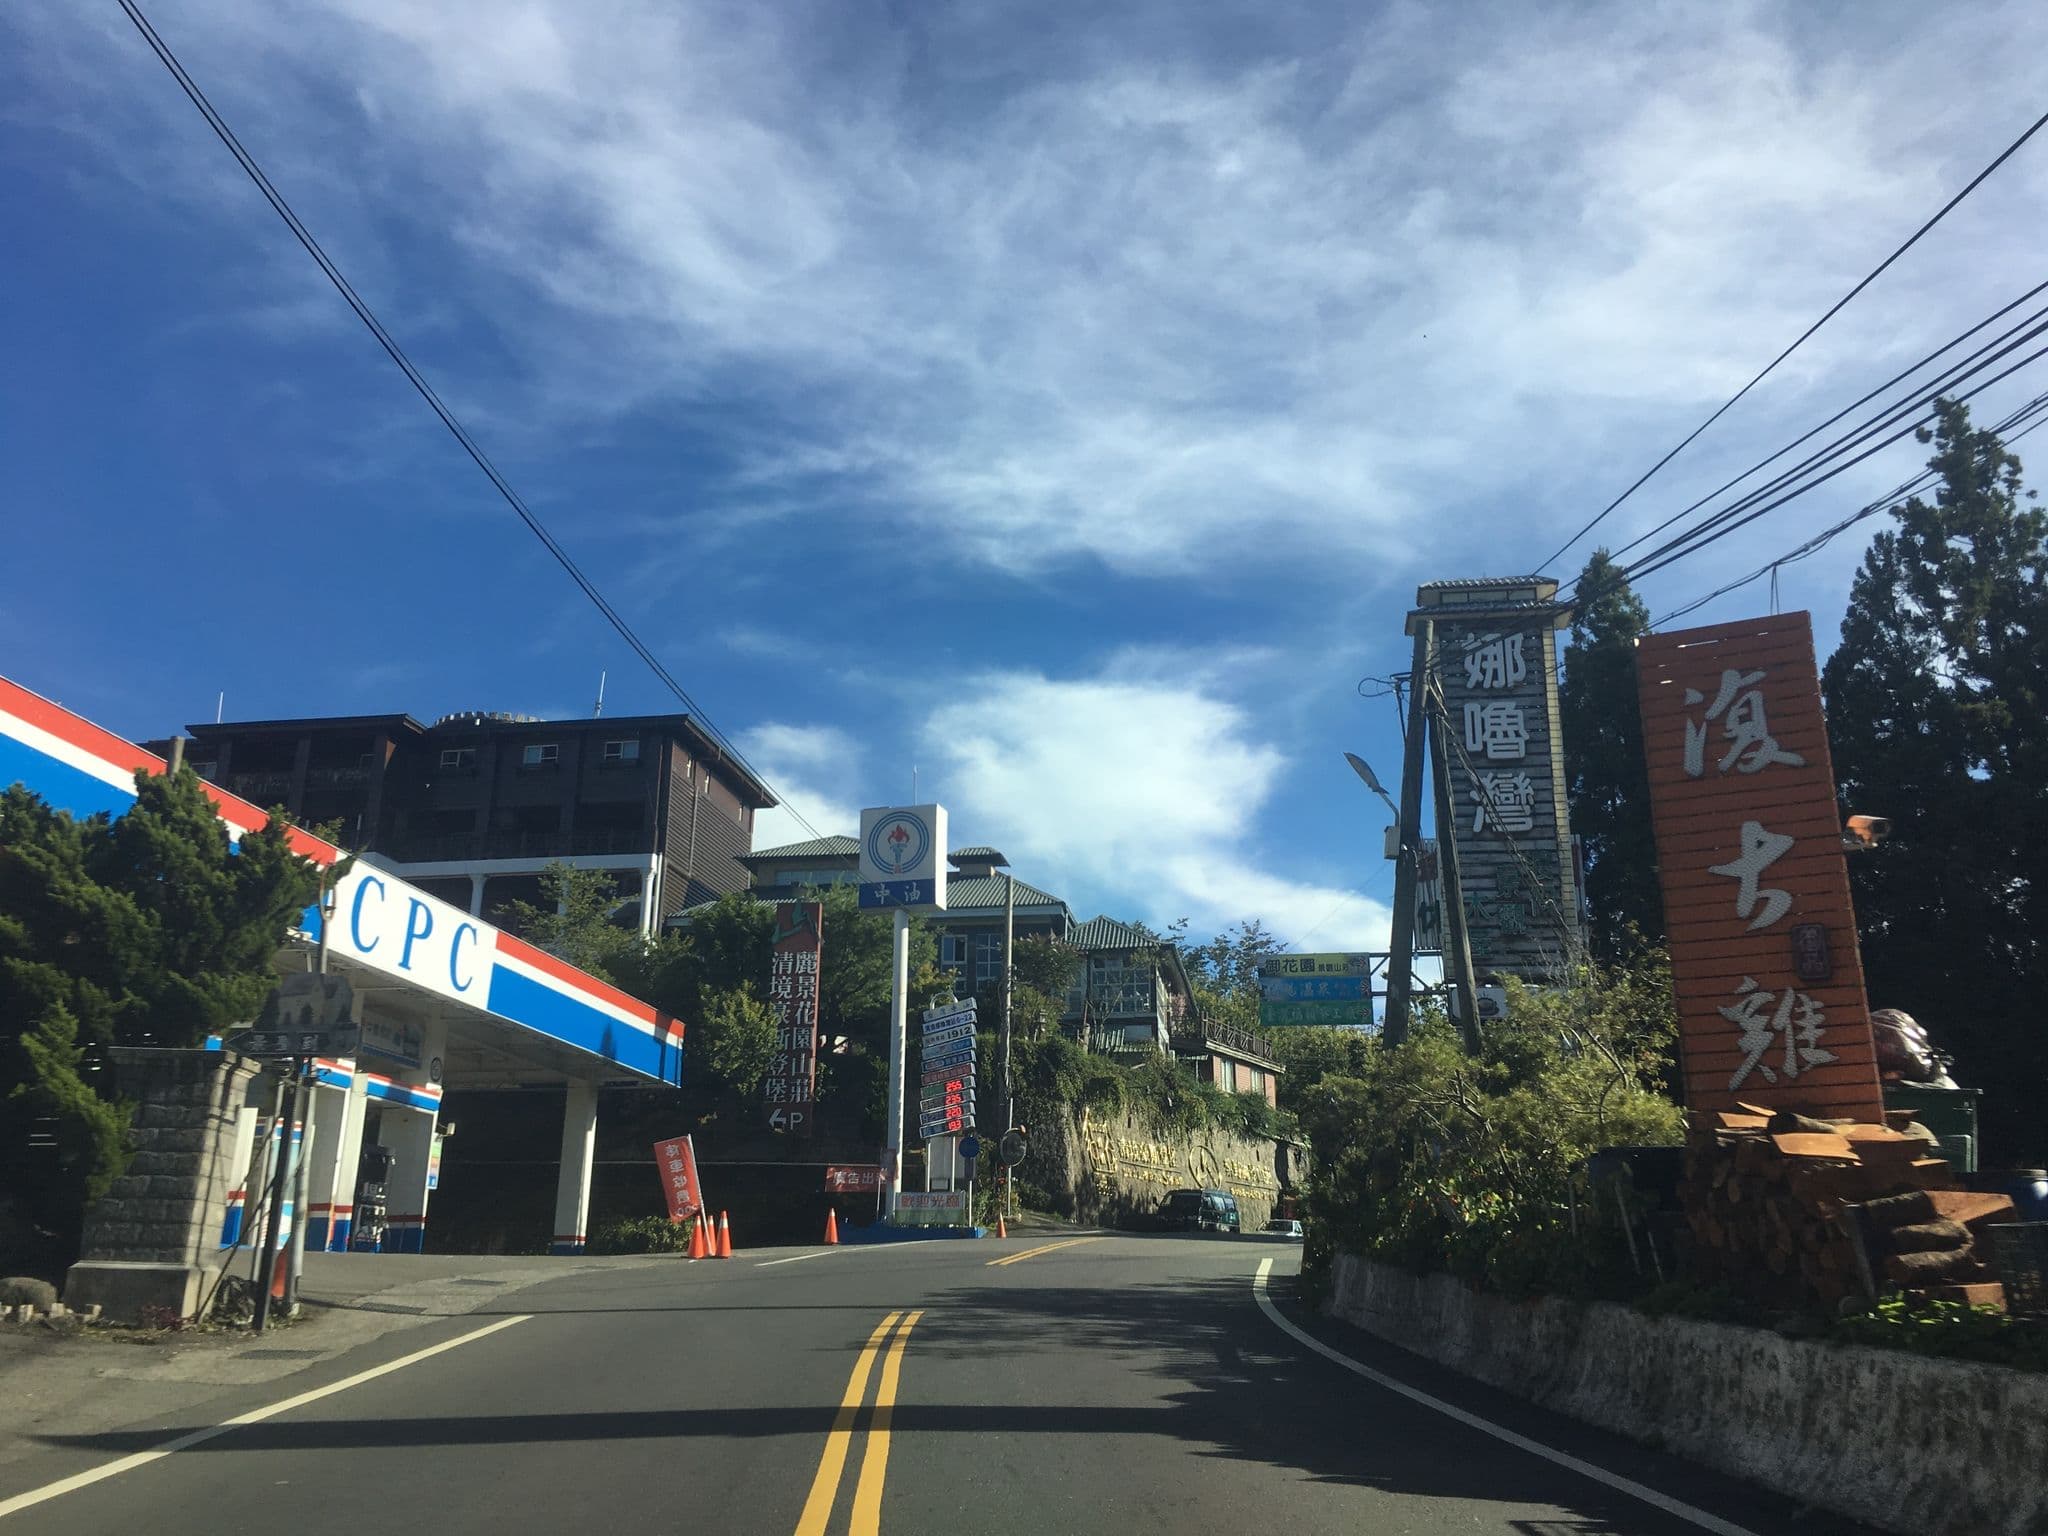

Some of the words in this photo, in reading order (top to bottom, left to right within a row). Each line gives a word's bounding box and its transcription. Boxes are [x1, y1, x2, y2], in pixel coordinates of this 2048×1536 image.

[1462, 631, 1536, 834] 娜嚕灣
[874, 881, 921, 905] 中油
[351, 875, 478, 992] CPC
[1265, 958, 1315, 973] 御花園
[790, 1112, 804, 1130] P
